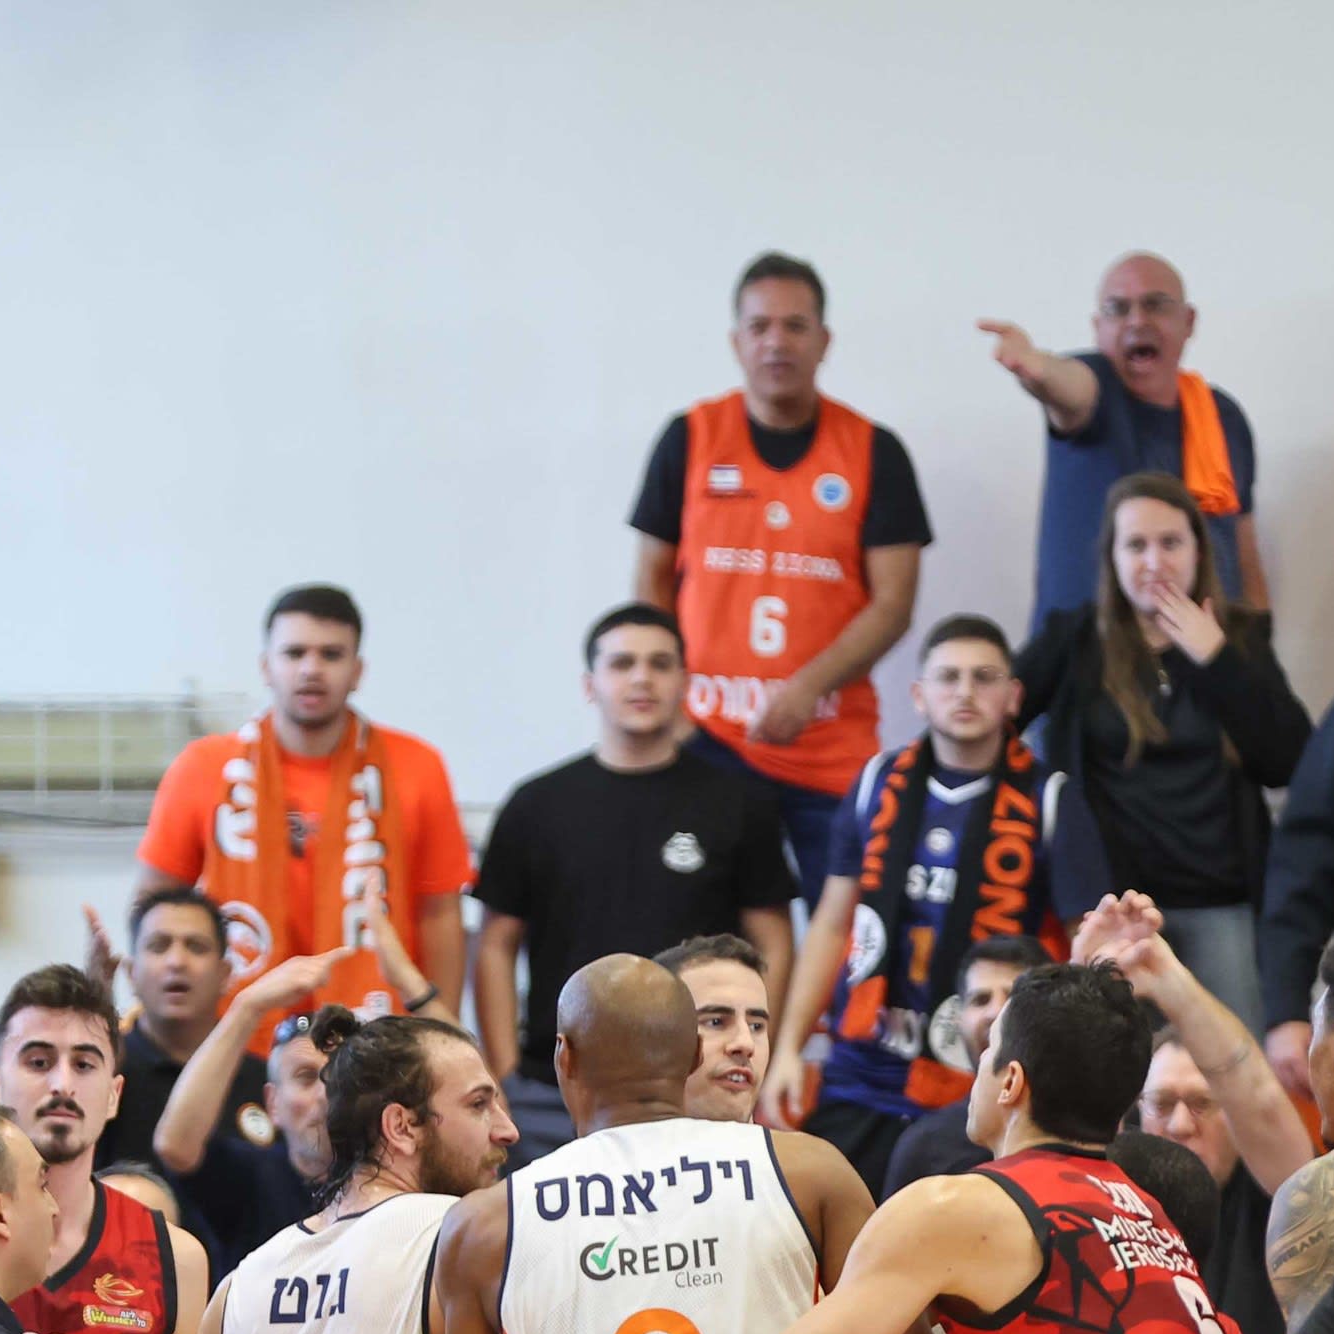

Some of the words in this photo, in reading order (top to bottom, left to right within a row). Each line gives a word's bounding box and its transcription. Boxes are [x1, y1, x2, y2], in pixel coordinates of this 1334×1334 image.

[750, 595, 789, 658] 6
[534, 1156, 755, 1221] ויליאמס
[580, 1236, 719, 1281] CREDIT
[675, 1271, 723, 1288] Clean
[269, 1267, 350, 1324] גוט
